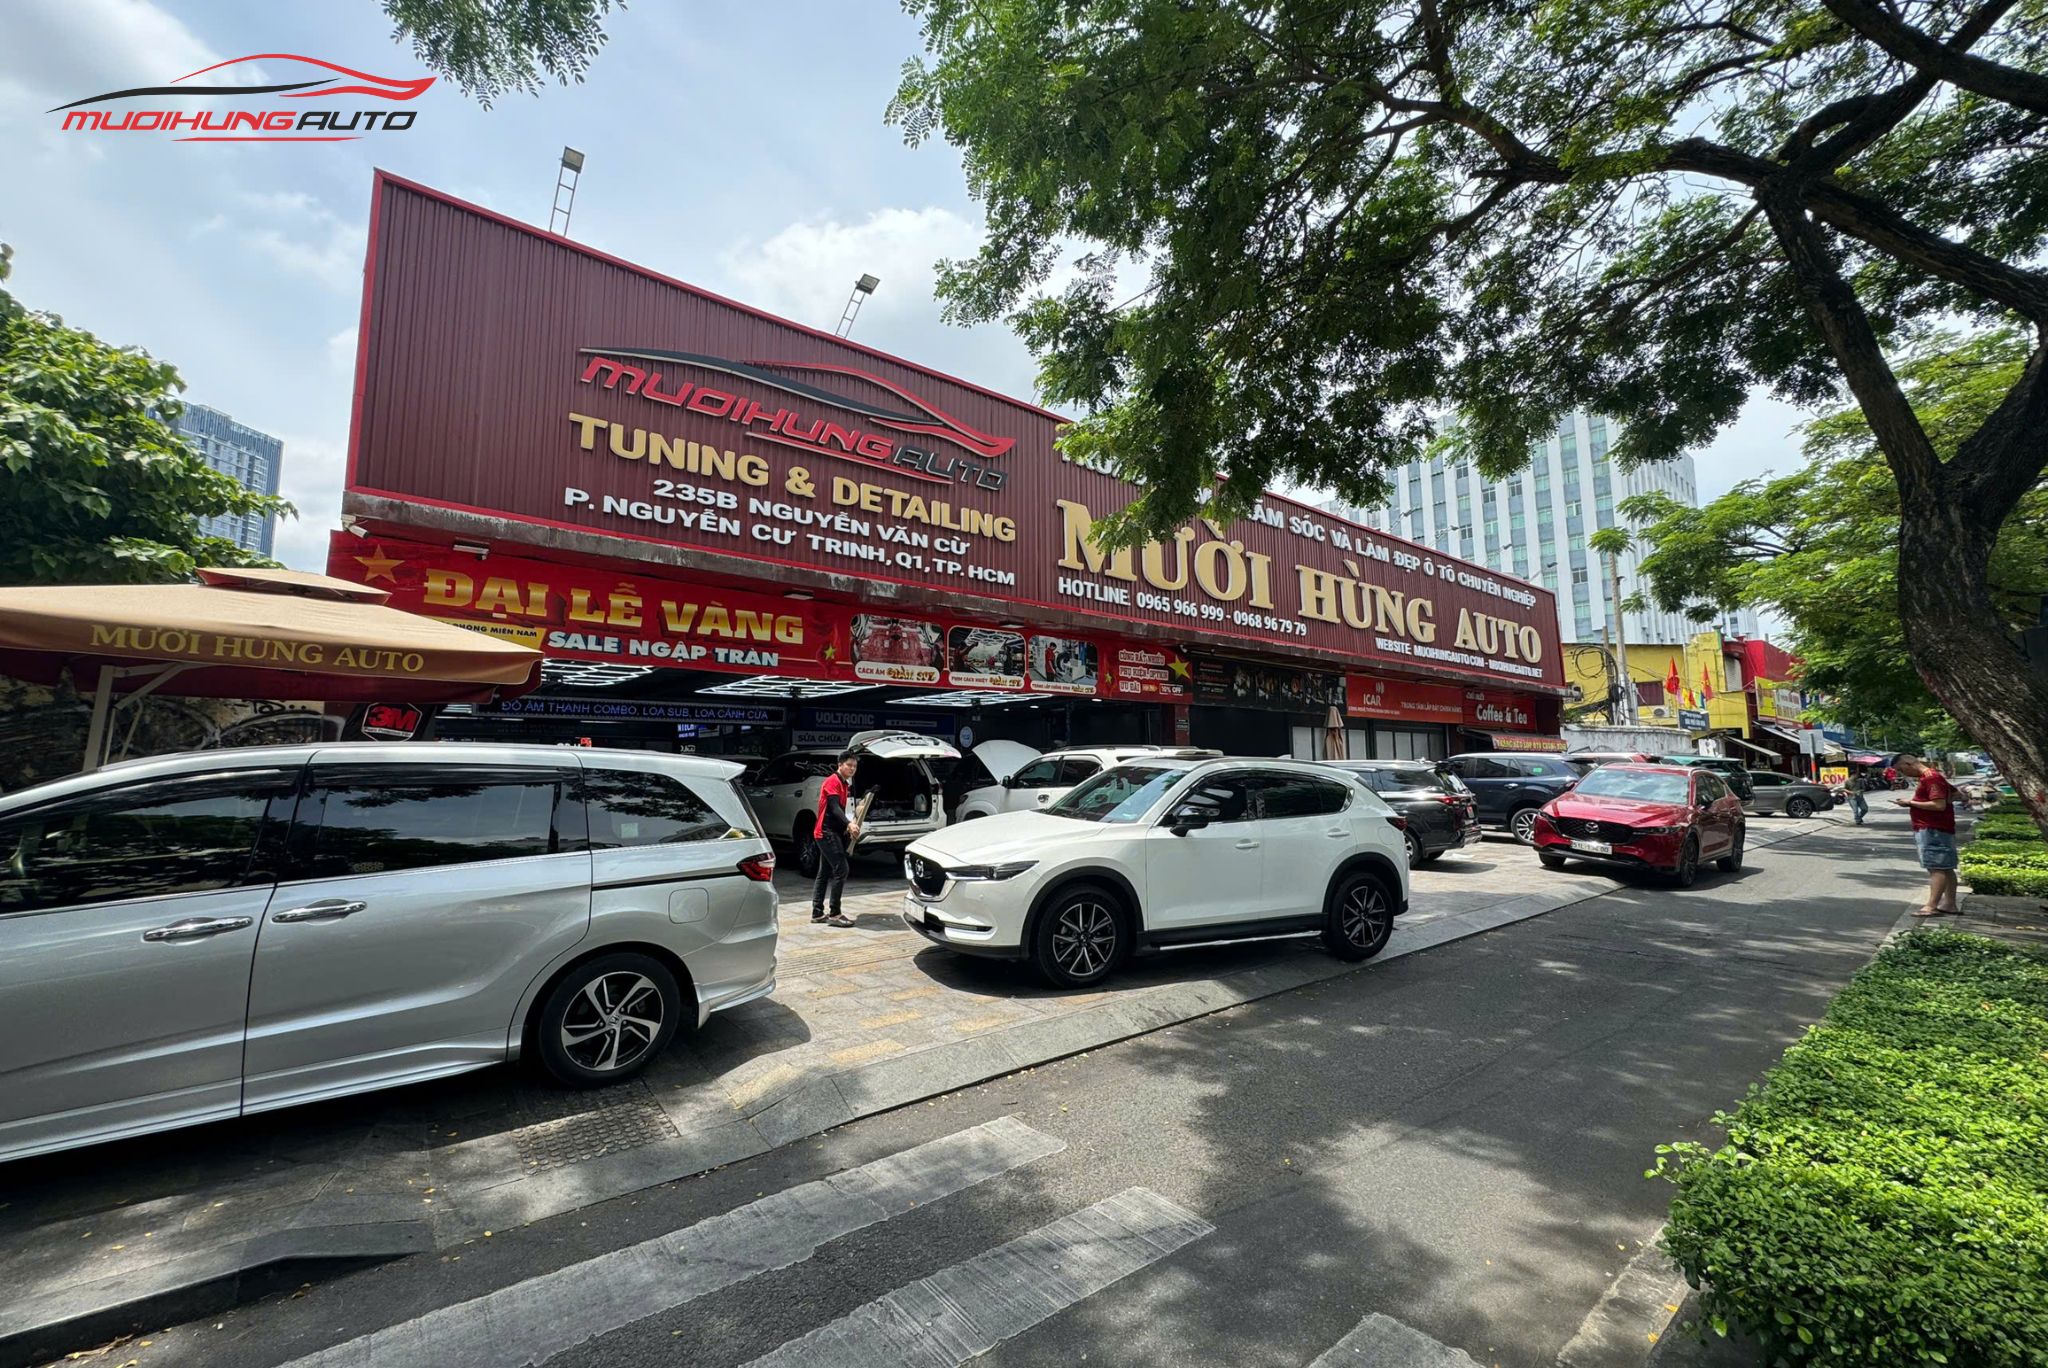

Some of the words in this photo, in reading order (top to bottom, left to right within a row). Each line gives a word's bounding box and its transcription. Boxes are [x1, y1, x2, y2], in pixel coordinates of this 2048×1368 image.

[568, 412, 769, 487] TUNING
[785, 466, 817, 498] &
[832, 476, 1016, 542] DETAILING
[564, 487, 595, 510] P.
[603, 494, 741, 536] NGUYỄN
[751, 524, 797, 545] CƯ
[653, 479, 738, 509] 235B
[750, 497, 870, 537] NGUYỄN
[876, 524, 928, 549] VĂN
[934, 535, 970, 555] CỪ
[1288, 513, 1326, 542] SÓC
[1330, 527, 1352, 551] VÀ
[1355, 536, 1390, 563] LÀM
[1393, 550, 1420, 573] ĐẸP
[1423, 557, 1435, 576] Ô
[1436, 563, 1456, 583] TÔ
[1457, 571, 1502, 597] CHUYÊN
[423, 568, 549, 618] ĐẠI
[569, 582, 643, 627] LỄ
[661, 600, 804, 644] VÀNG
[1136, 591, 1171, 613] 0965
[1174, 598, 1198, 618] 966
[1201, 604, 1224, 622] 999
[1233, 610, 1262, 629] 0968
[1295, 559, 1437, 643] HÙNG
[1454, 607, 1543, 663] AUTO
[517, 629, 537, 638] NAM
[548, 631, 620, 654] SALE
[629, 639, 708, 663] NGẬP
[714, 646, 779, 667] TRÀN
[333, 647, 425, 672] AUTO
[367, 705, 417, 731] 3M
[547, 702, 590, 713] THANH
[643, 706, 665, 716] LOA
[694, 708, 716, 718] LOA
[815, 711, 875, 725] VOLTRONIC
[1363, 694, 1381, 706] ICAR
[1476, 704, 1503, 722] Coffee
[1513, 708, 1528, 724] Tea
